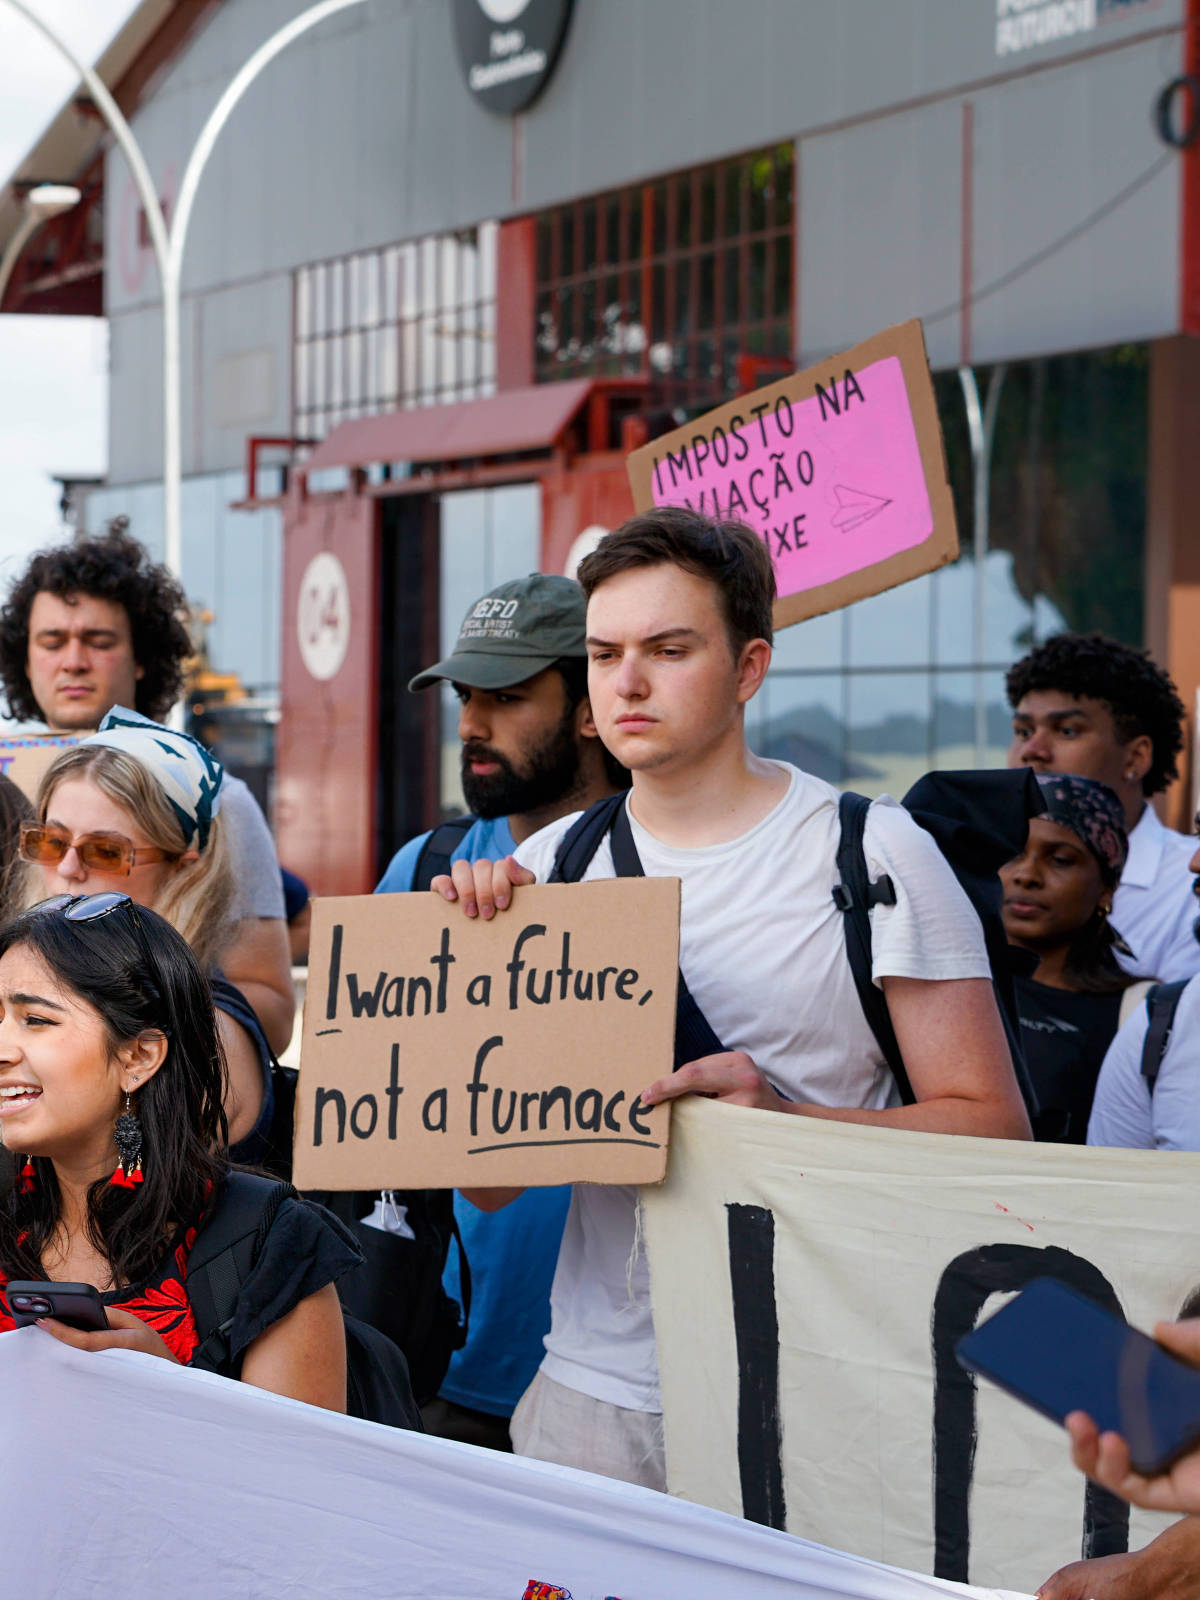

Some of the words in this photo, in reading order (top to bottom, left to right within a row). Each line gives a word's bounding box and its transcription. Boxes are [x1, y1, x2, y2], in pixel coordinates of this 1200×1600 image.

[653, 395, 794, 496] IMPOSTO
[814, 368, 866, 422] NA
[684, 449, 814, 520] VIAÇÃO
[763, 513, 809, 558] IXE
[326, 924, 343, 1021] I
[346, 926, 456, 1019] want
[465, 974, 492, 1008] a
[506, 923, 654, 1011] future,
[313, 1042, 404, 1147] not
[421, 1087, 448, 1134] a
[466, 1035, 655, 1137] furnace
